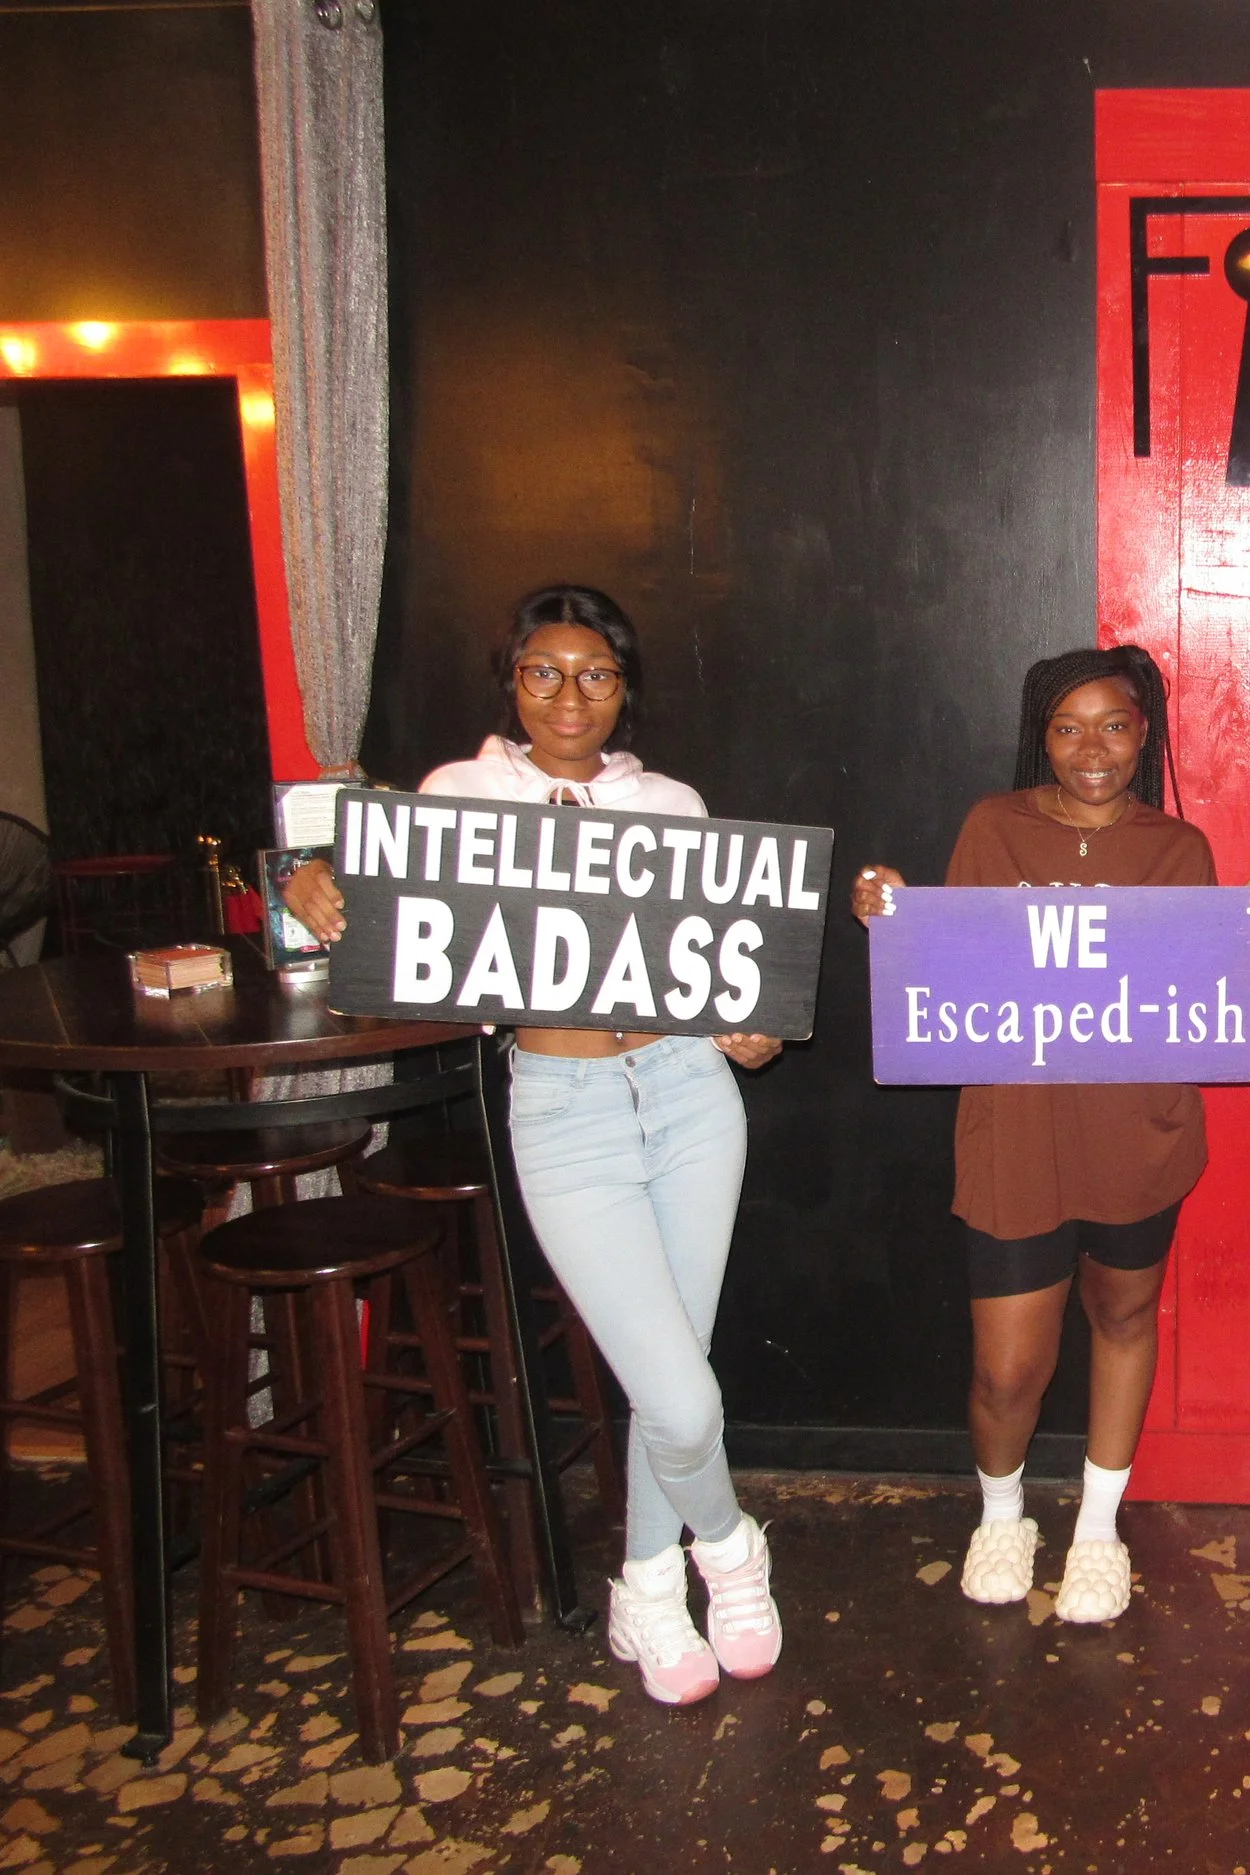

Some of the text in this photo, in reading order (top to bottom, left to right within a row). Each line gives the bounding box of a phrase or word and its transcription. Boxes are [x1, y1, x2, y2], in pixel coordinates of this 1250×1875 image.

[342, 801, 820, 911] INTELLECTUAL
[393, 896, 764, 1023] BADASS
[1027, 905, 1108, 968] WE
[905, 975, 1246, 1066] Escaped-ish
